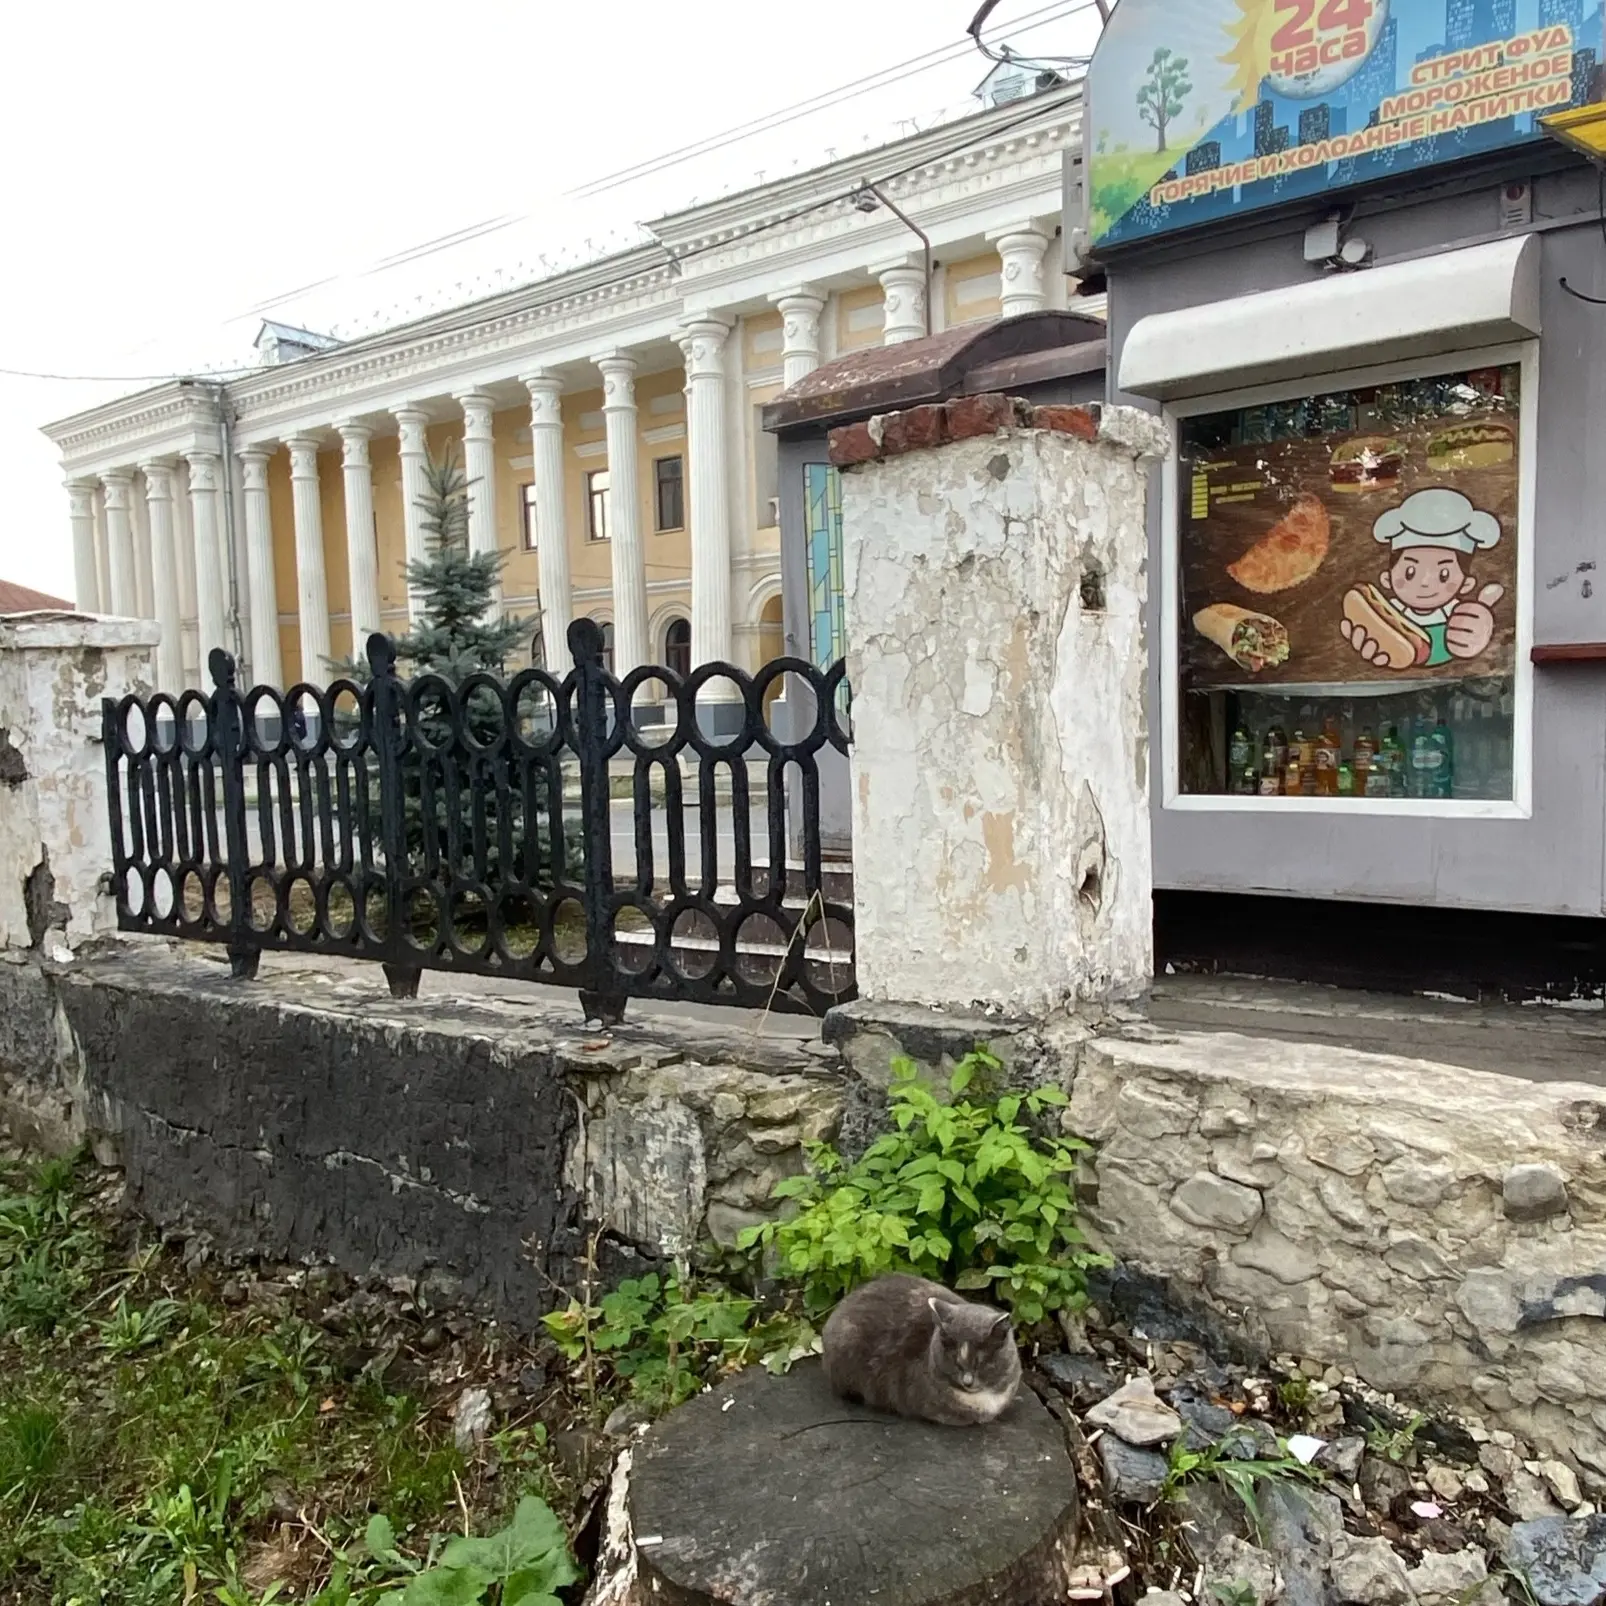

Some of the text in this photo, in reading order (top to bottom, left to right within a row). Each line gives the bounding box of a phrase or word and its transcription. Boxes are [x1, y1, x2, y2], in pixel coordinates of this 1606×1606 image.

[1270, 0, 1373, 52] 24
[1411, 26, 1570, 85] СТРИТ ФУД
[1382, 53, 1570, 119] МОРОЖЕНОЕ
[1152, 81, 1570, 205] ГОРЯЧИЕ И ХОЛОДНЫЕ НАПИТКИ
